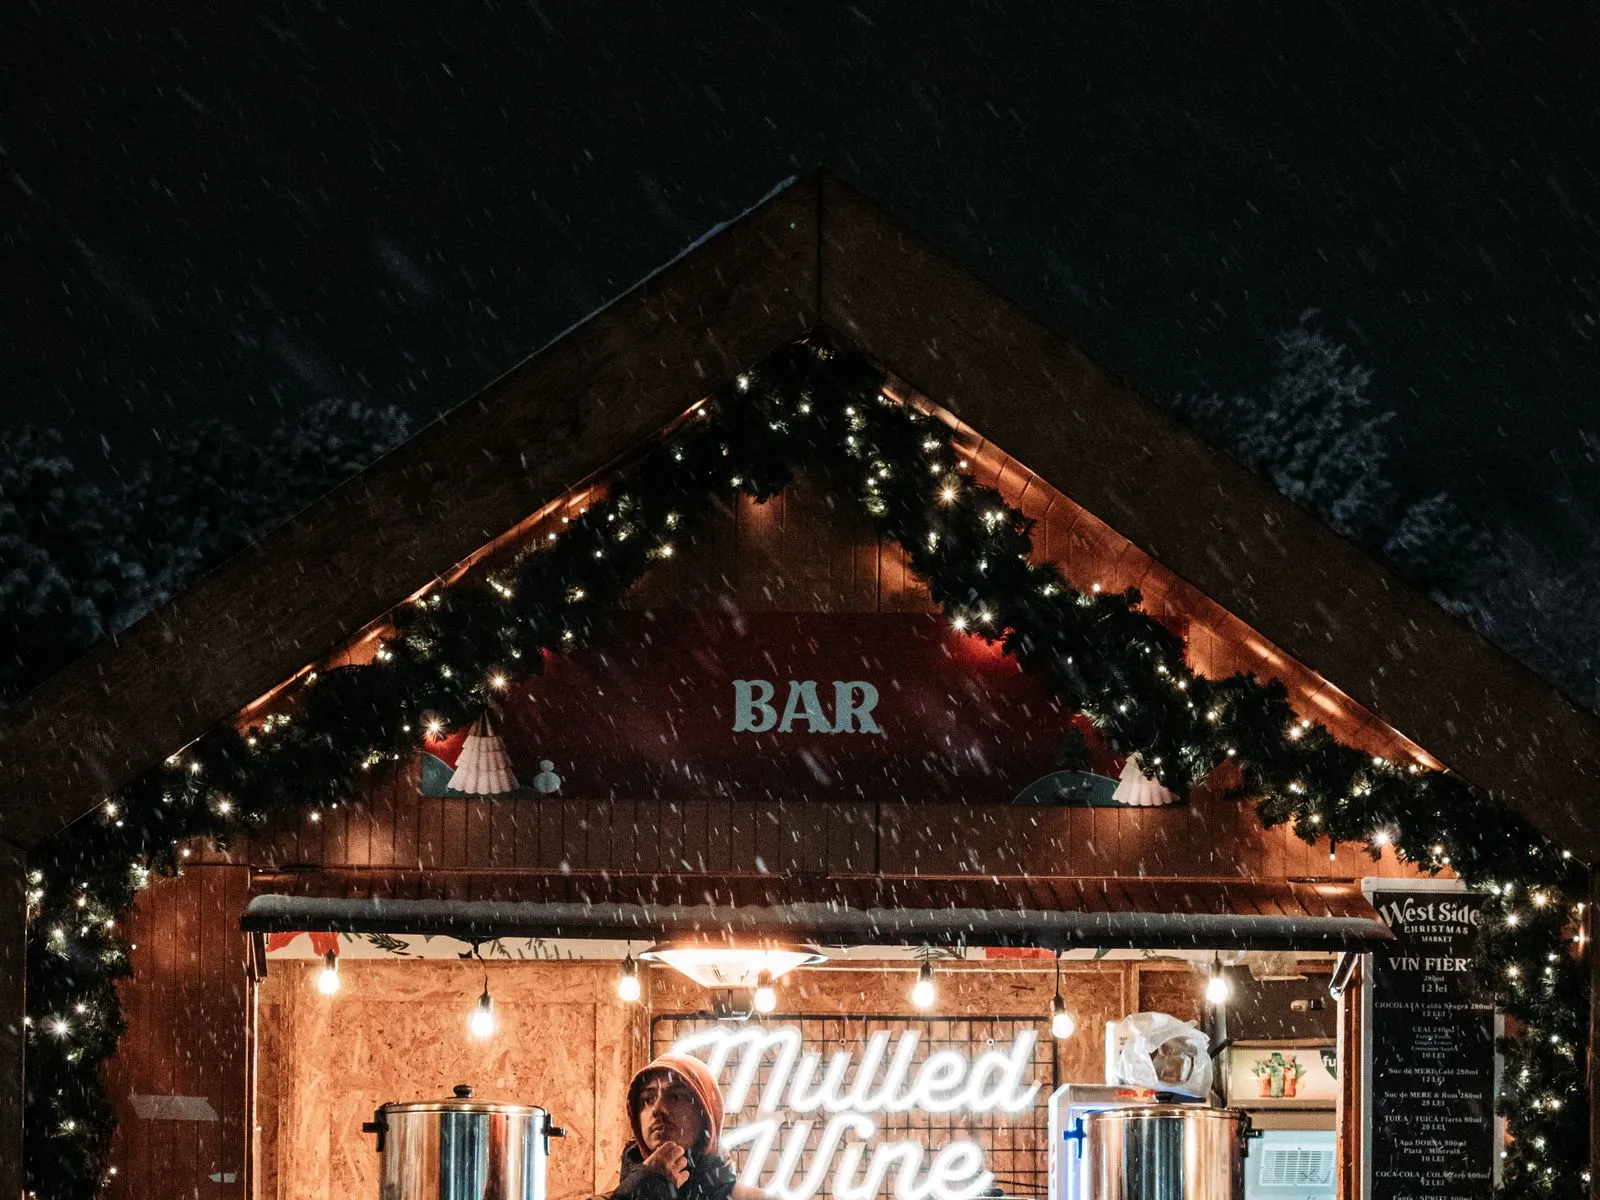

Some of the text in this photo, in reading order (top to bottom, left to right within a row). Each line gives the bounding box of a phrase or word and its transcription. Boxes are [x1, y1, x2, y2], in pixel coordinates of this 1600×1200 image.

[732, 679, 881, 734] BAR
[1379, 898, 1481, 928] West Side
[1404, 925, 1469, 935] CHRISTMAS
[1388, 957, 1472, 972] VIN FIER
[1421, 984, 1448, 993] 12 lei
[671, 1026, 1041, 1112] Mulled
